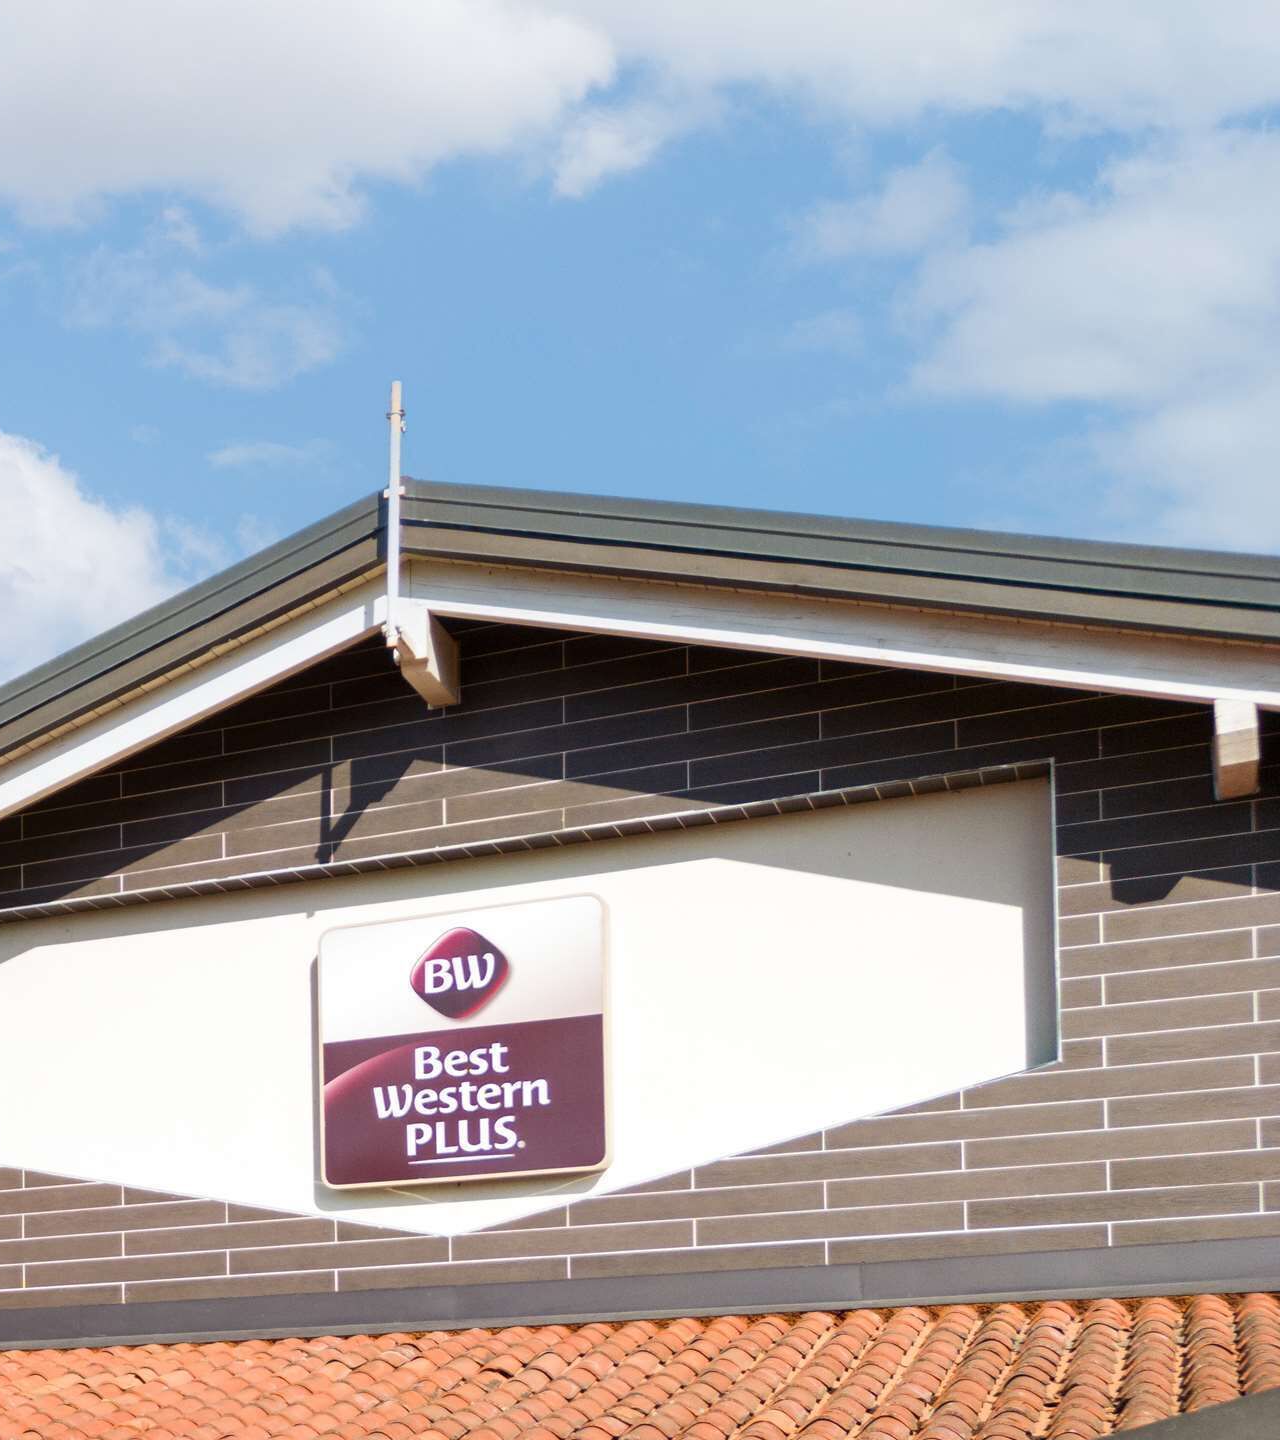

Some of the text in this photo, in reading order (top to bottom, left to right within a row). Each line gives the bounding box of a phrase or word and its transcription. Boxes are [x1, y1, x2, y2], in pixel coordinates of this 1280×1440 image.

[424, 952, 495, 994] BW
[414, 1042, 510, 1081] Best
[372, 1078, 552, 1120] Western
